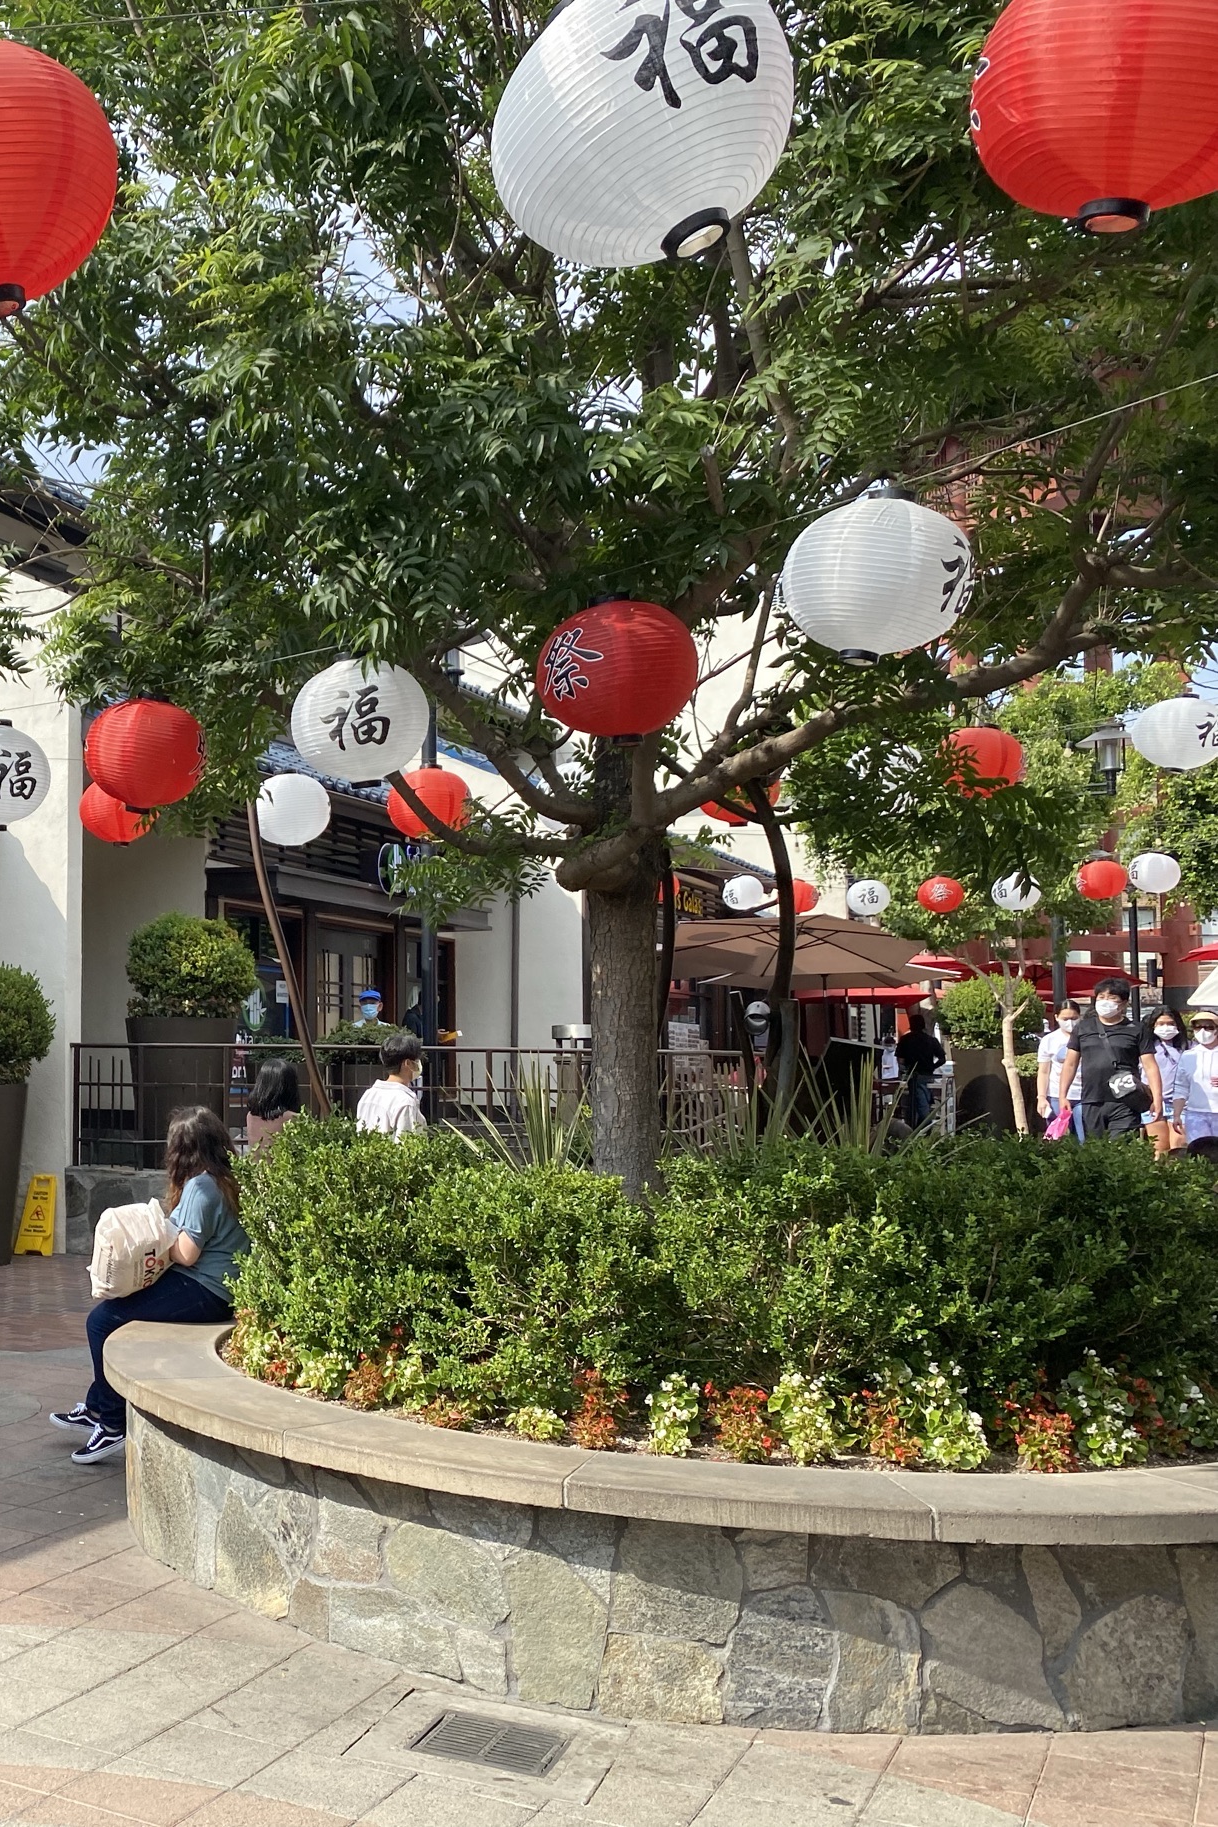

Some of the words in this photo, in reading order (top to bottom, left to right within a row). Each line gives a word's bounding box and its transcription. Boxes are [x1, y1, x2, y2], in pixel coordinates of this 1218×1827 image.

[543, 627, 604, 702] 祭
[320, 684, 391, 751] 福
[858, 886, 879, 905] 福
[1108, 1074, 1137, 1094] Y-3
